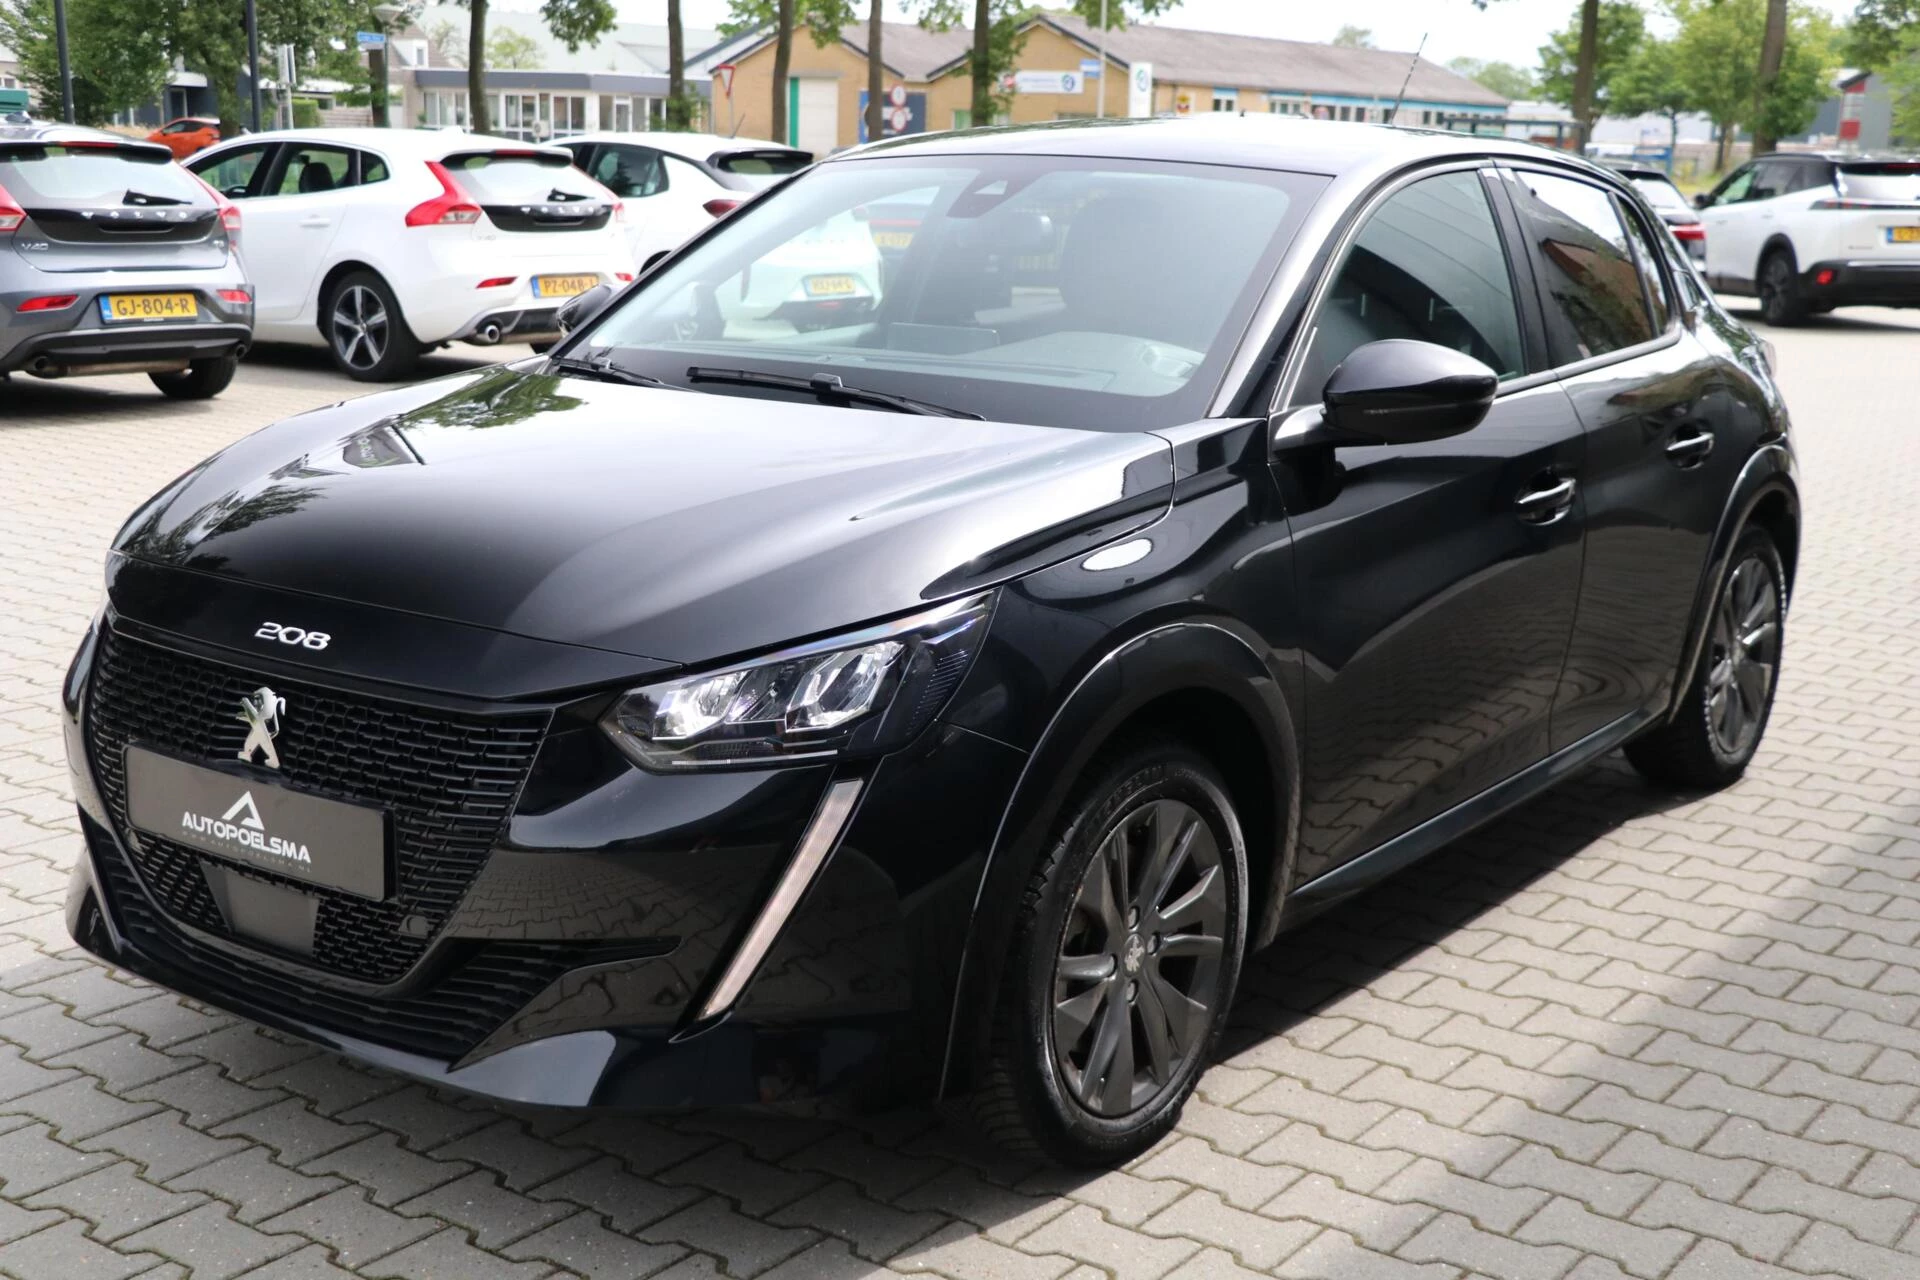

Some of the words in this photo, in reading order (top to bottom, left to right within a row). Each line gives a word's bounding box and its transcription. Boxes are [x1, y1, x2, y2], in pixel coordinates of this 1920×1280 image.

[116, 297, 190, 316] GJ-804-R
[254, 621, 331, 650] 208
[181, 810, 312, 864] AUTOPOELSMA
